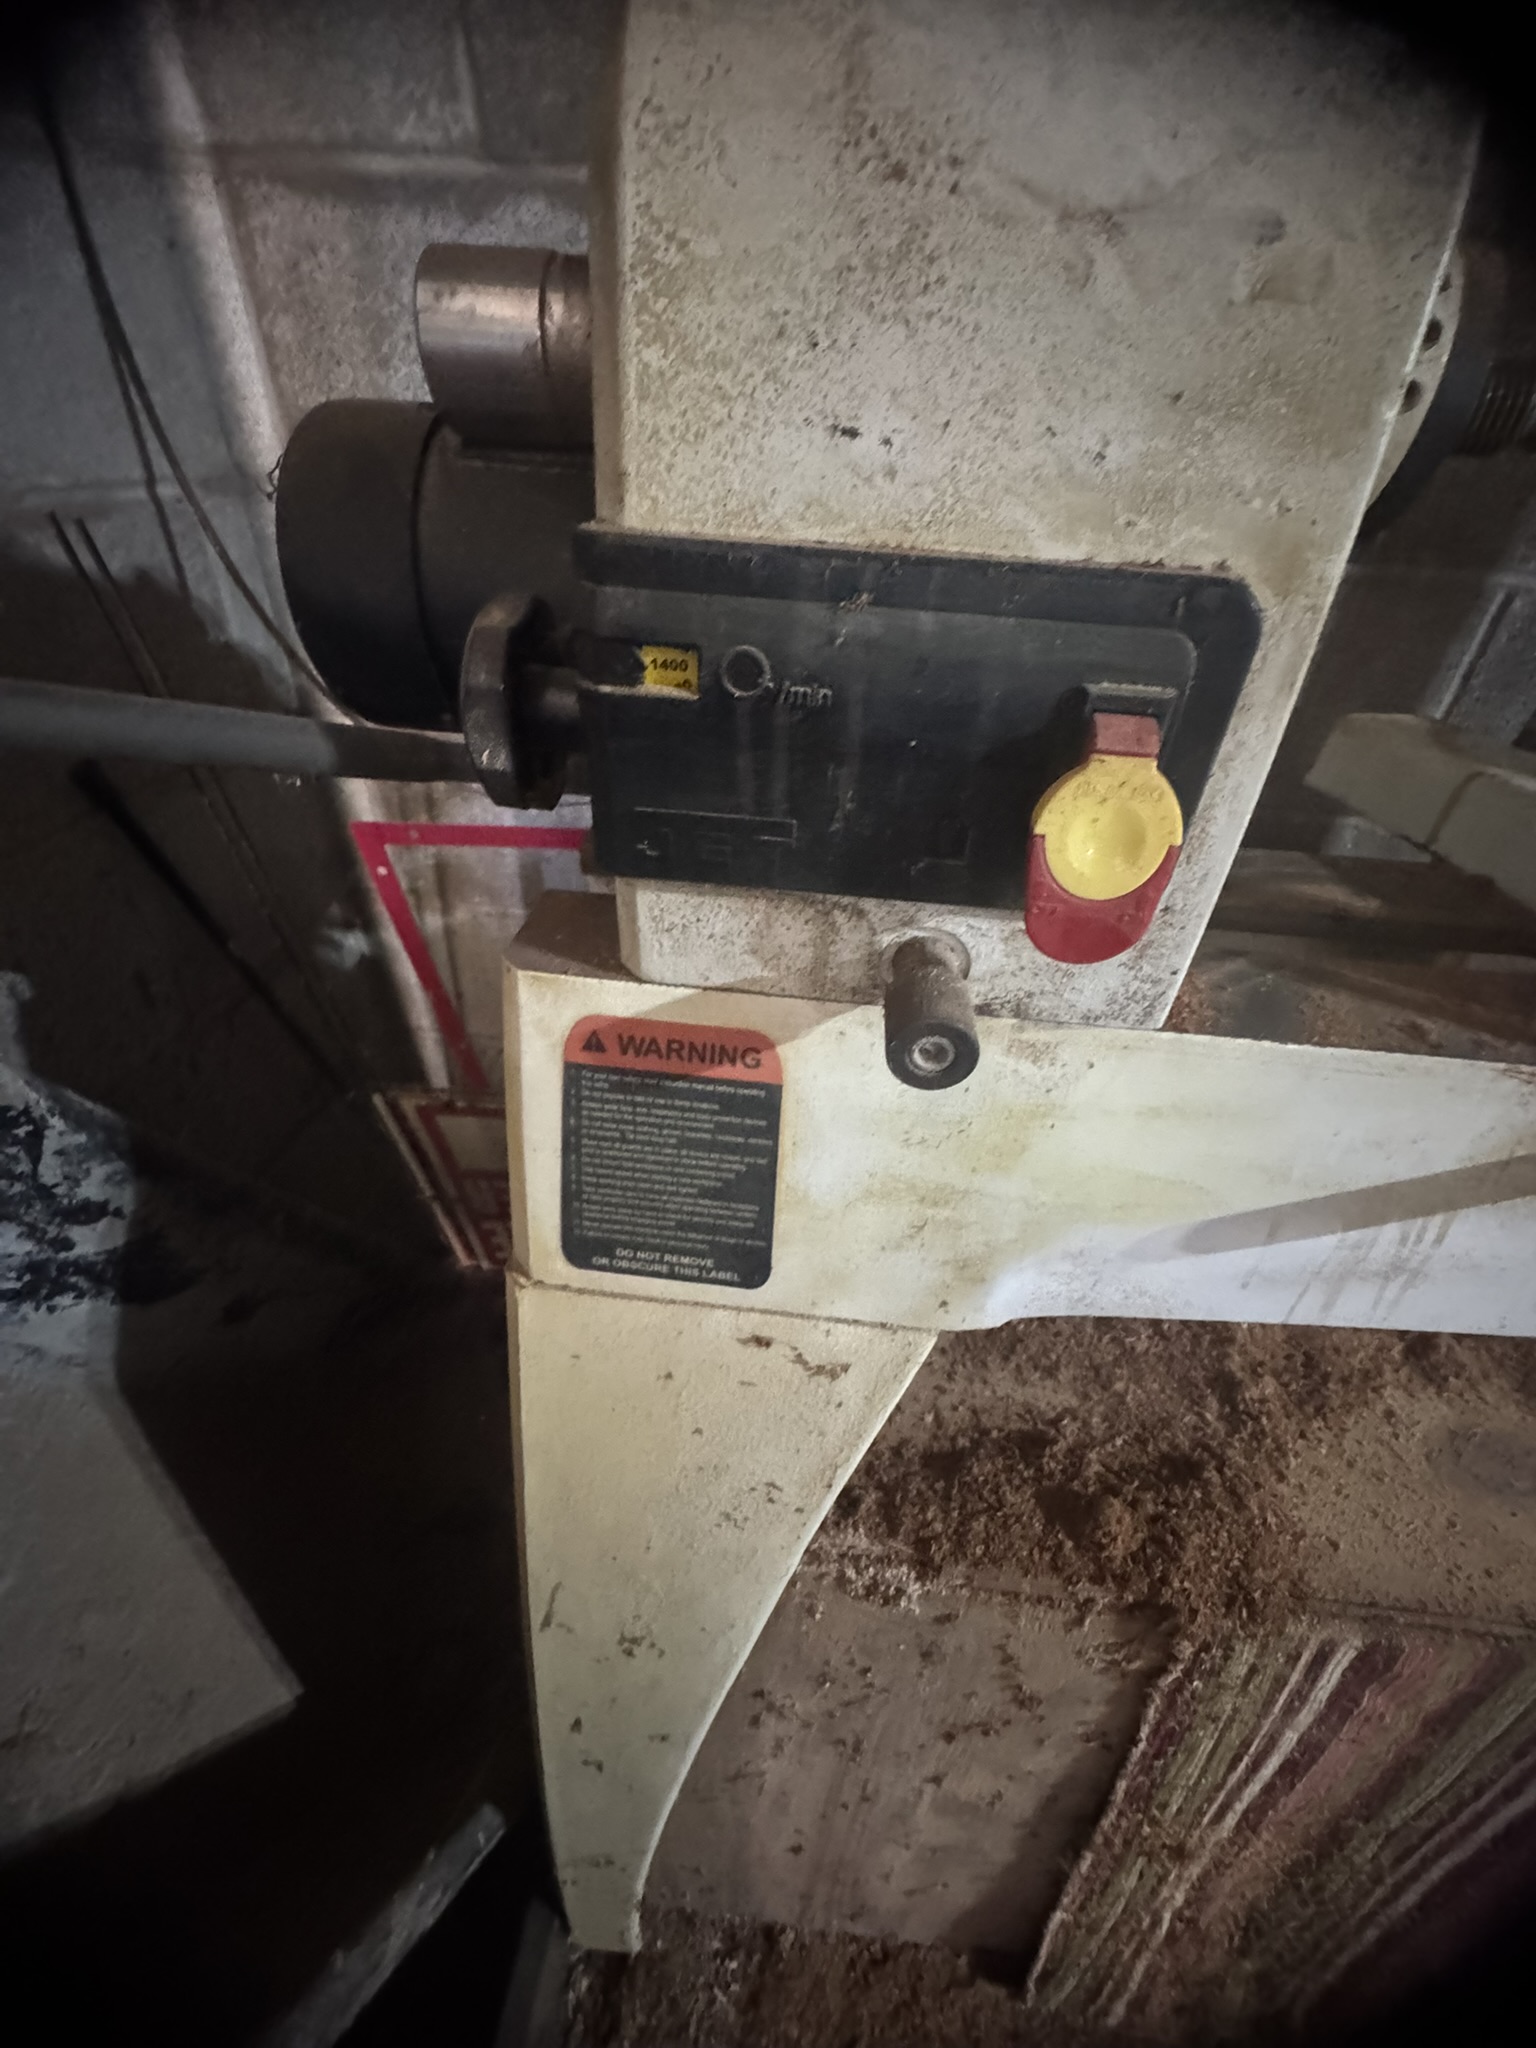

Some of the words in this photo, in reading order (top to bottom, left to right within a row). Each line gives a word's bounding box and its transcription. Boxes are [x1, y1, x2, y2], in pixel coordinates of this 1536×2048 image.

[649, 657, 689, 672] 1400
[617, 1032, 762, 1069] WARNING
[591, 1255, 610, 1267] OR
[612, 1258, 671, 1274] OBSCURE
[674, 1265, 699, 1277] THIS
[702, 1269, 741, 1282] LABEL
[615, 1247, 634, 1259] DO
[636, 1250, 661, 1262] NOT
[663, 1253, 715, 1268] REMOVE
